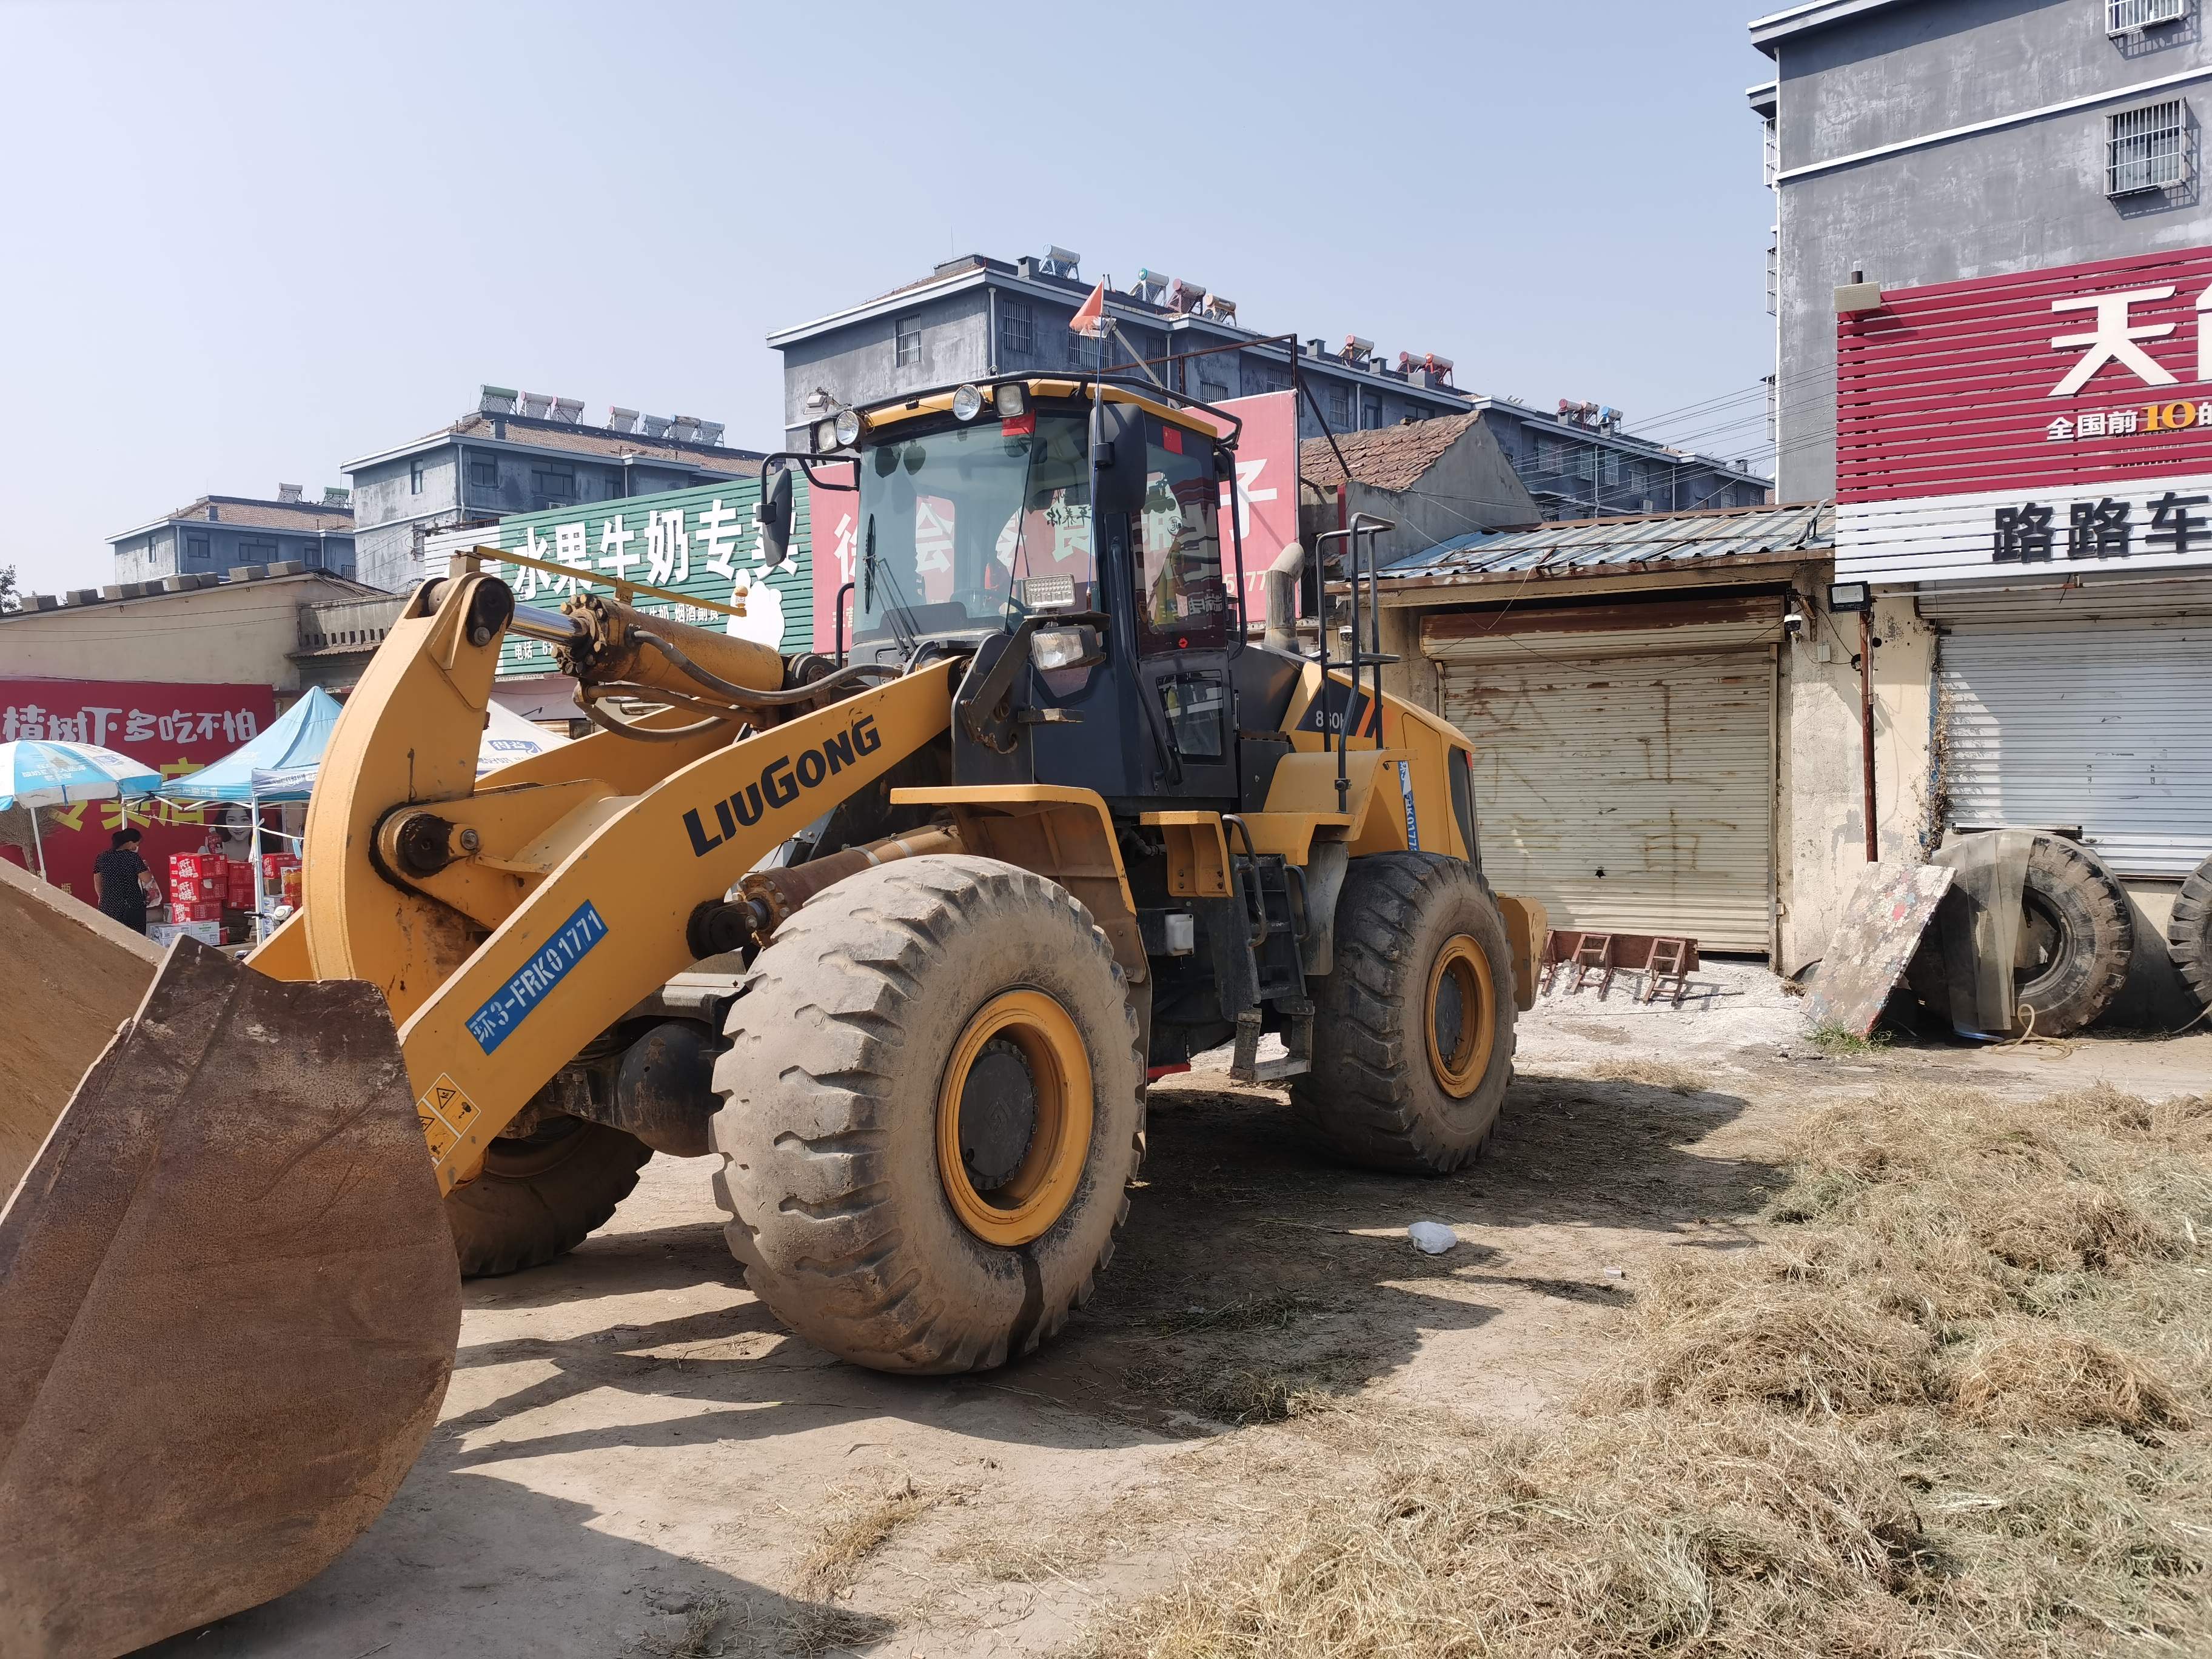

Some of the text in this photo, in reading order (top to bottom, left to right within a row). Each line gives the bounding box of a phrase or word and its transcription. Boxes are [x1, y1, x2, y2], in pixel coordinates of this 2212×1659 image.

[2047, 285, 2212, 397] 天
[1991, 492, 2212, 563] 路路车
[515, 640, 533, 660] 电话
